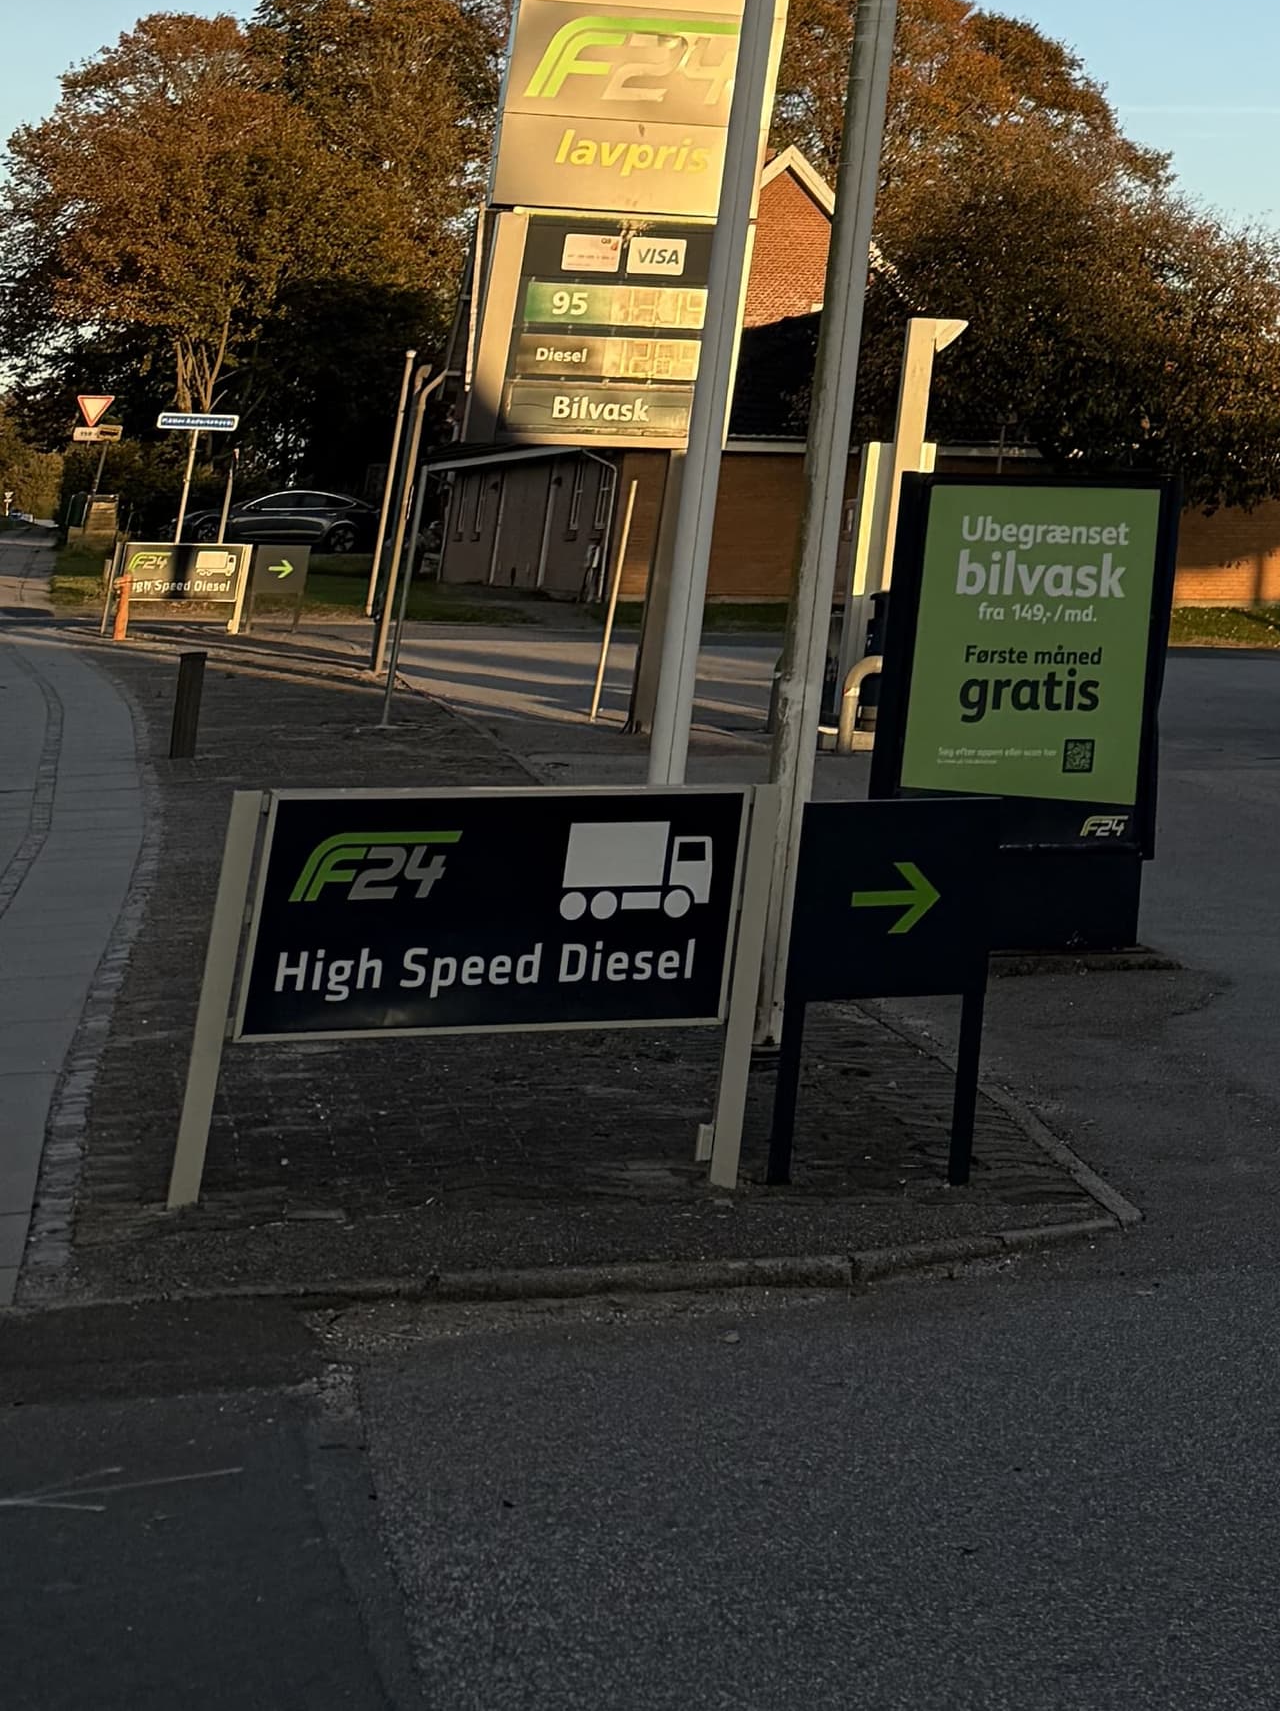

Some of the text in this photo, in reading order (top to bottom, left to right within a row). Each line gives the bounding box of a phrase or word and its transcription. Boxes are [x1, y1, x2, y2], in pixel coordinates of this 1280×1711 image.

[523, 15, 741, 106] F24
[554, 128, 710, 177] lavpris
[638, 248, 680, 265] VISA
[551, 291, 589, 316] 95
[534, 346, 588, 364] Diesel
[551, 395, 650, 424] Bilvask
[961, 515, 1129, 550] Ubegrænset
[128, 551, 173, 572] F24
[956, 549, 1126, 598] bilvask
[130, 578, 231, 594] igh Speed Diesel
[978, 602, 1005, 621] fra
[964, 644, 1103, 665] Første måned
[959, 667, 1100, 724] gratis
[1080, 815, 1129, 838] F24
[288, 830, 463, 903] F24
[274, 938, 697, 1002] High Speed Diesel
